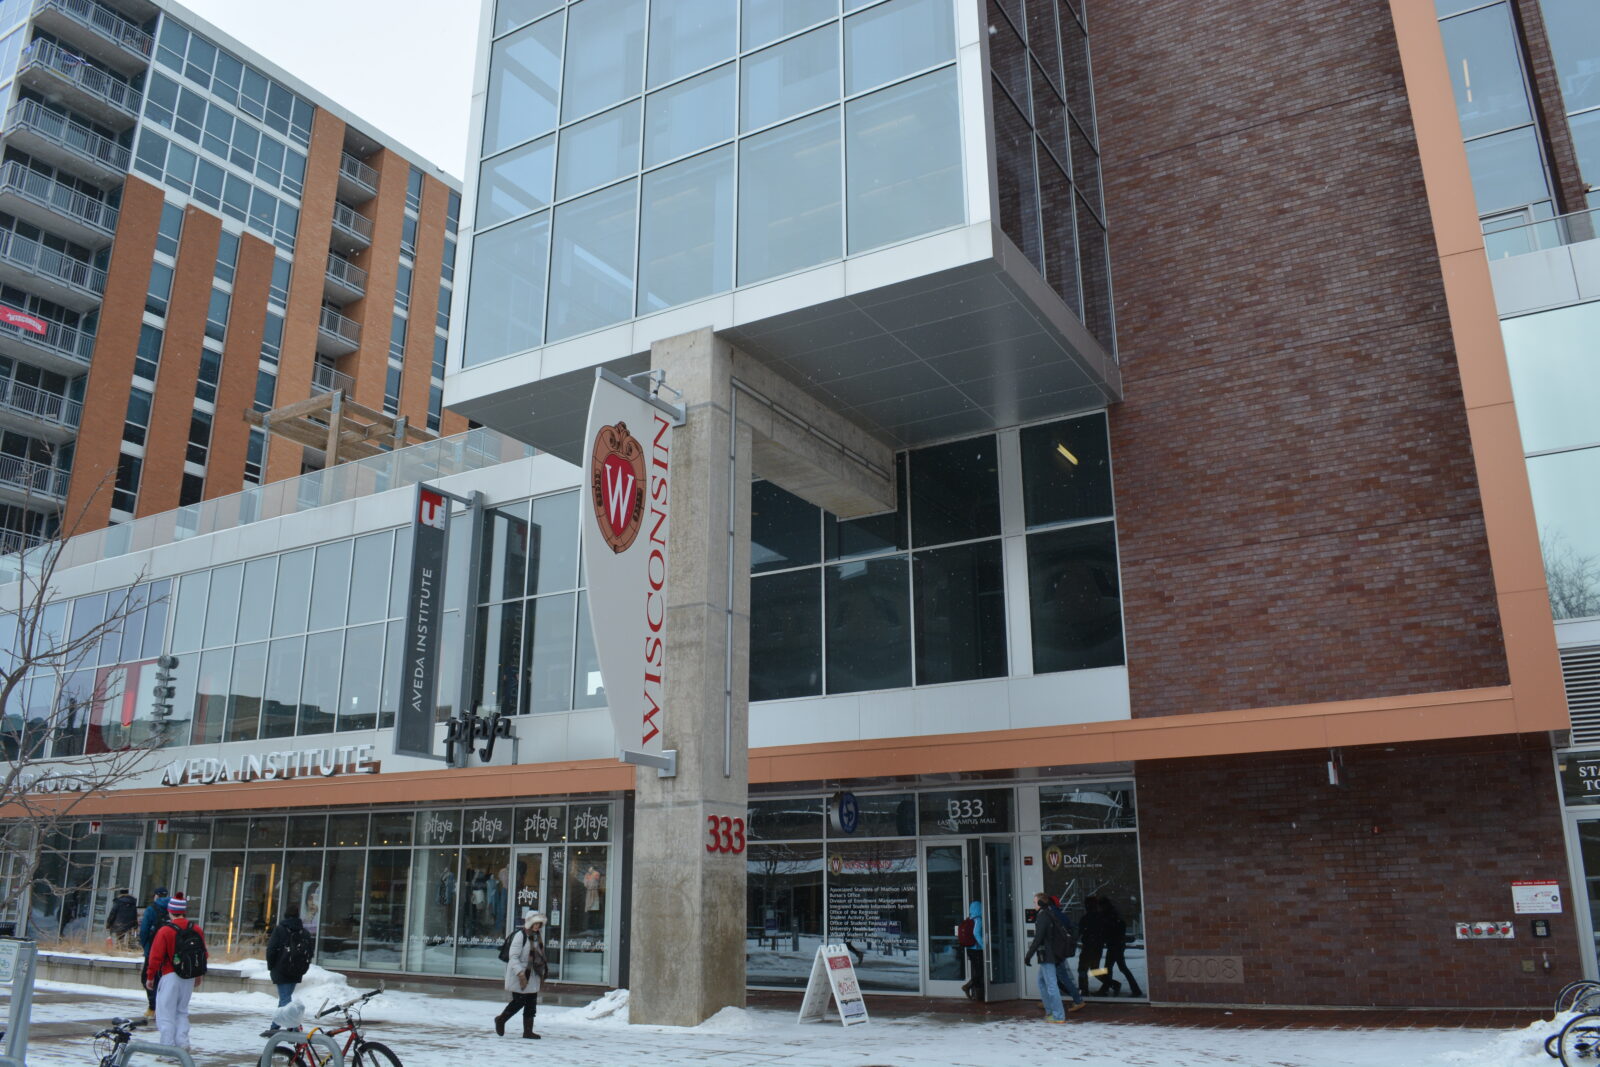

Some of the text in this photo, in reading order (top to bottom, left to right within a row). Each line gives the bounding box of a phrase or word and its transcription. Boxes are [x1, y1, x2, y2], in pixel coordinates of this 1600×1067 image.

[642, 410, 670, 749] WISCONSIN
[412, 567, 433, 712] AVEDA INSTITUTE
[443, 710, 514, 764] pitaya
[161, 744, 376, 785] AVEDA INSTITUTE
[574, 807, 608, 840] pitaya
[950, 799, 984, 818] 333
[424, 813, 453, 843] pitaya
[471, 811, 503, 843] pitaya
[524, 809, 558, 841] pitaya
[706, 815, 746, 854] 333
[518, 885, 538, 906] pitaya
[1171, 958, 1238, 979] 2008
